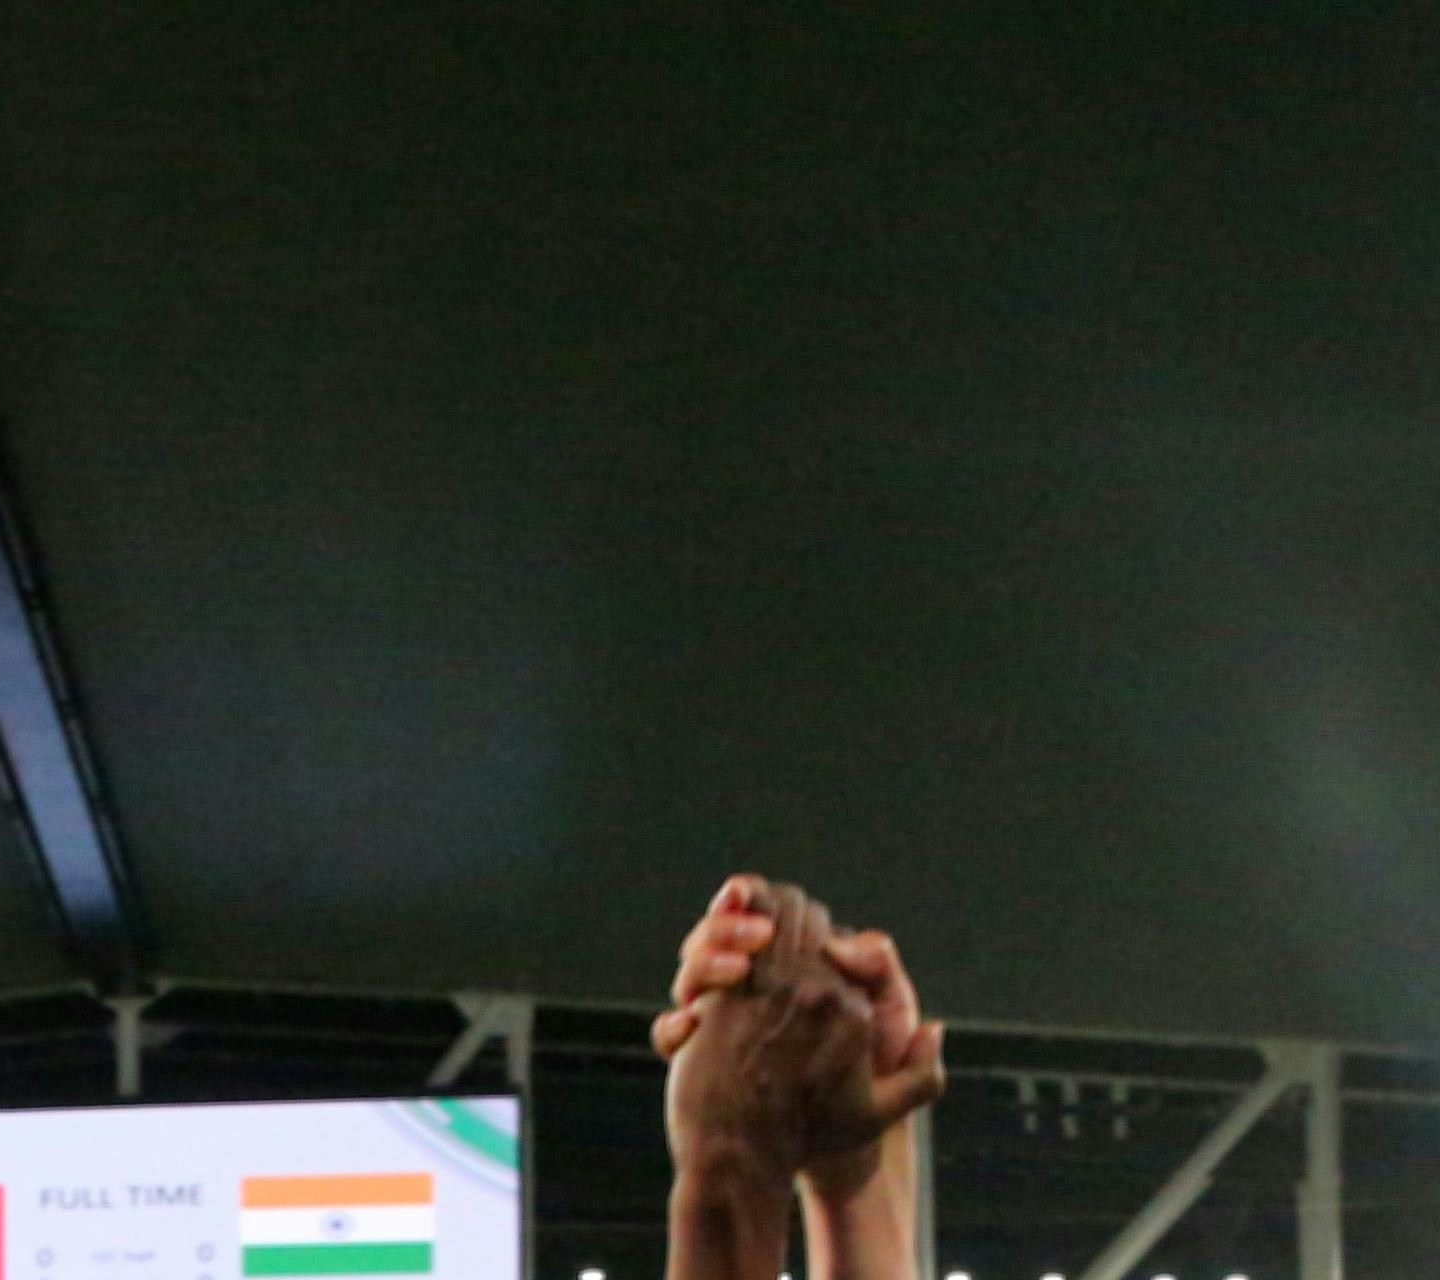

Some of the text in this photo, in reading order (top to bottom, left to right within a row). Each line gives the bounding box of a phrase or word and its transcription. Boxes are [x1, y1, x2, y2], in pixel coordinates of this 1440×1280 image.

[39, 1184, 204, 1211] FULL TIME
[36, 1242, 216, 1269] 0 0
